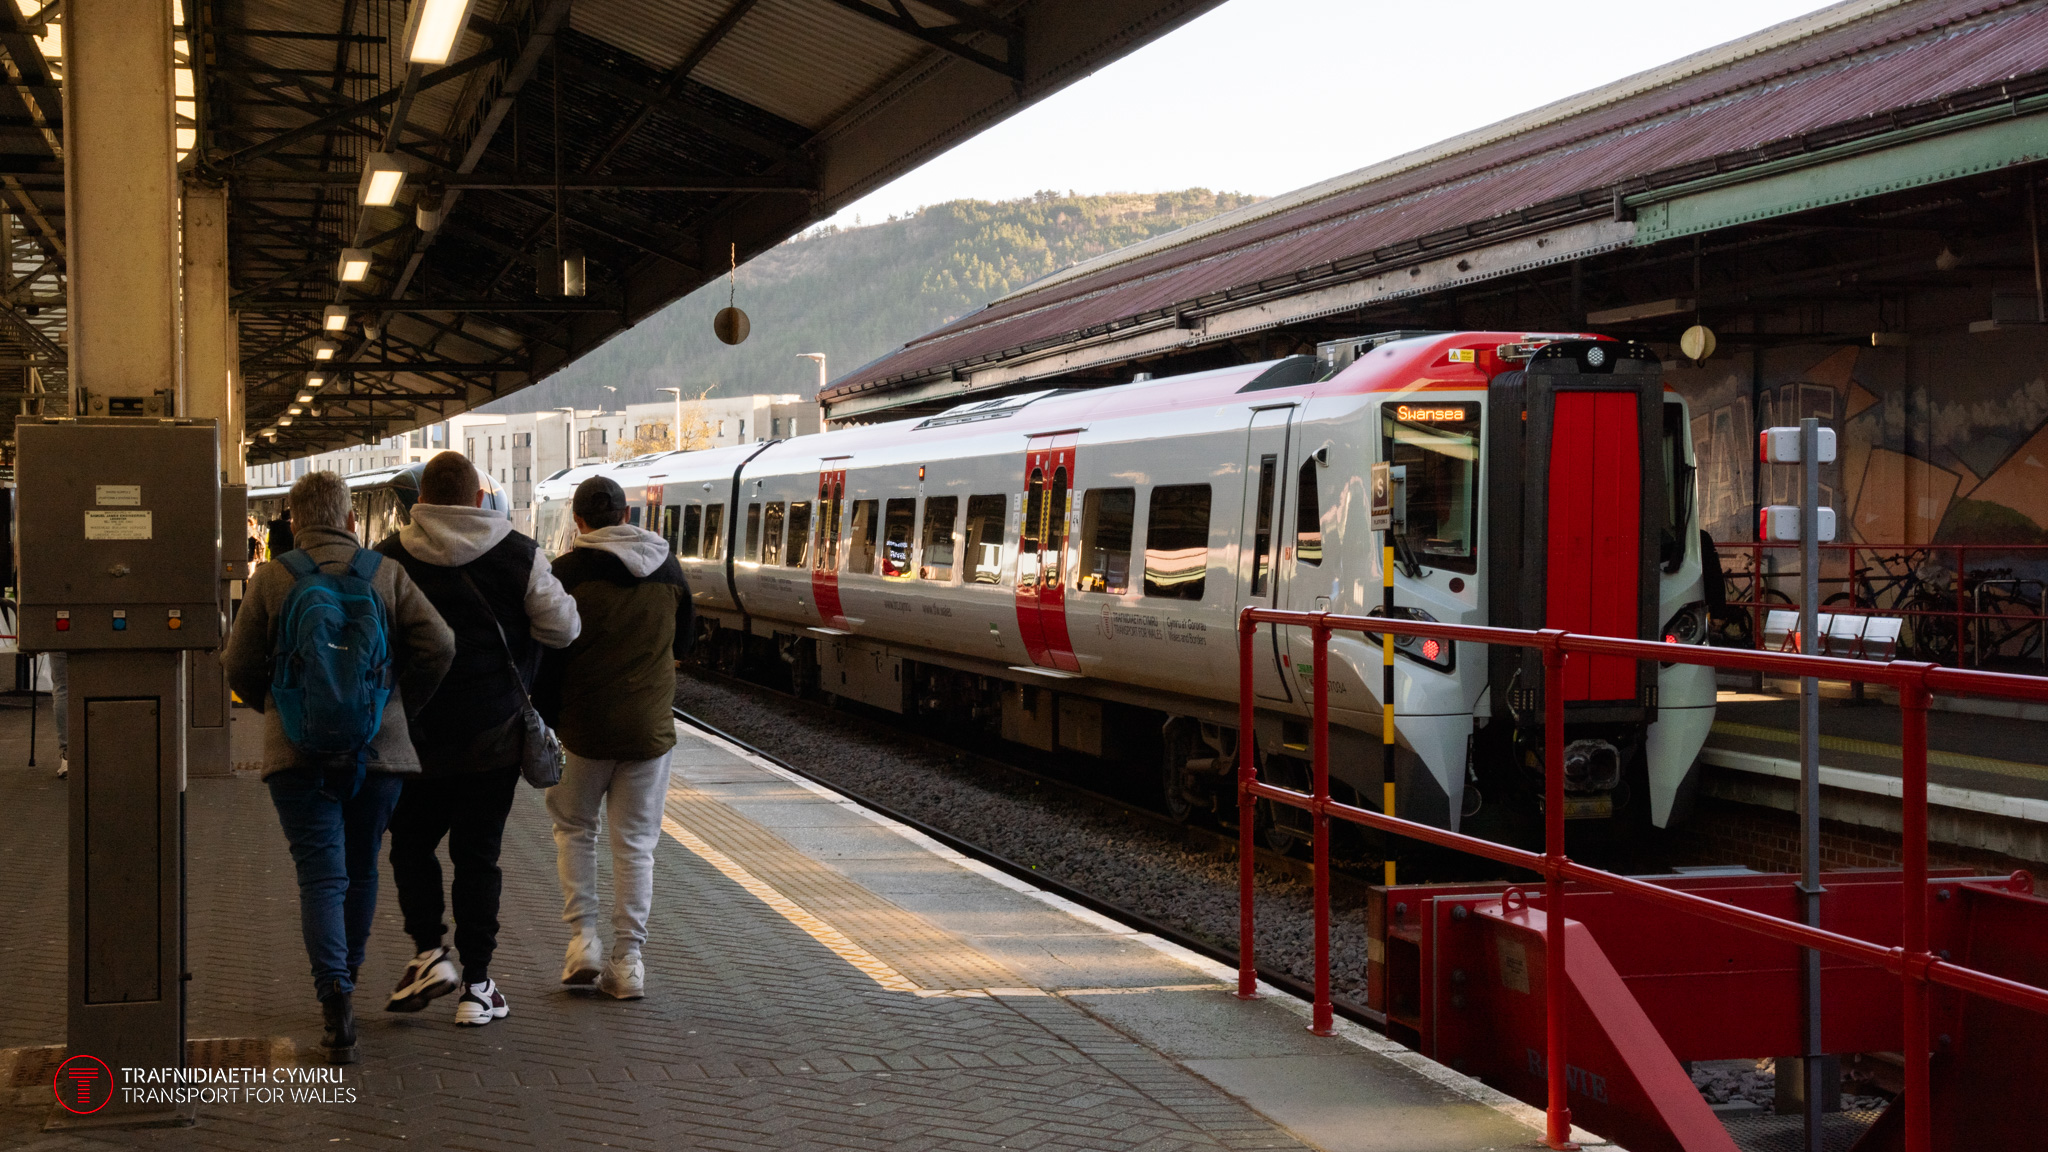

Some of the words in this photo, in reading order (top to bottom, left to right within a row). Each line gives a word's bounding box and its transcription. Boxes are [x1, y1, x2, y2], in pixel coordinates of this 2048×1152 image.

[1397, 405, 1465, 421] Swansea
[1377, 477, 1384, 499] S
[1527, 1048, 1608, 1104] RWIE
